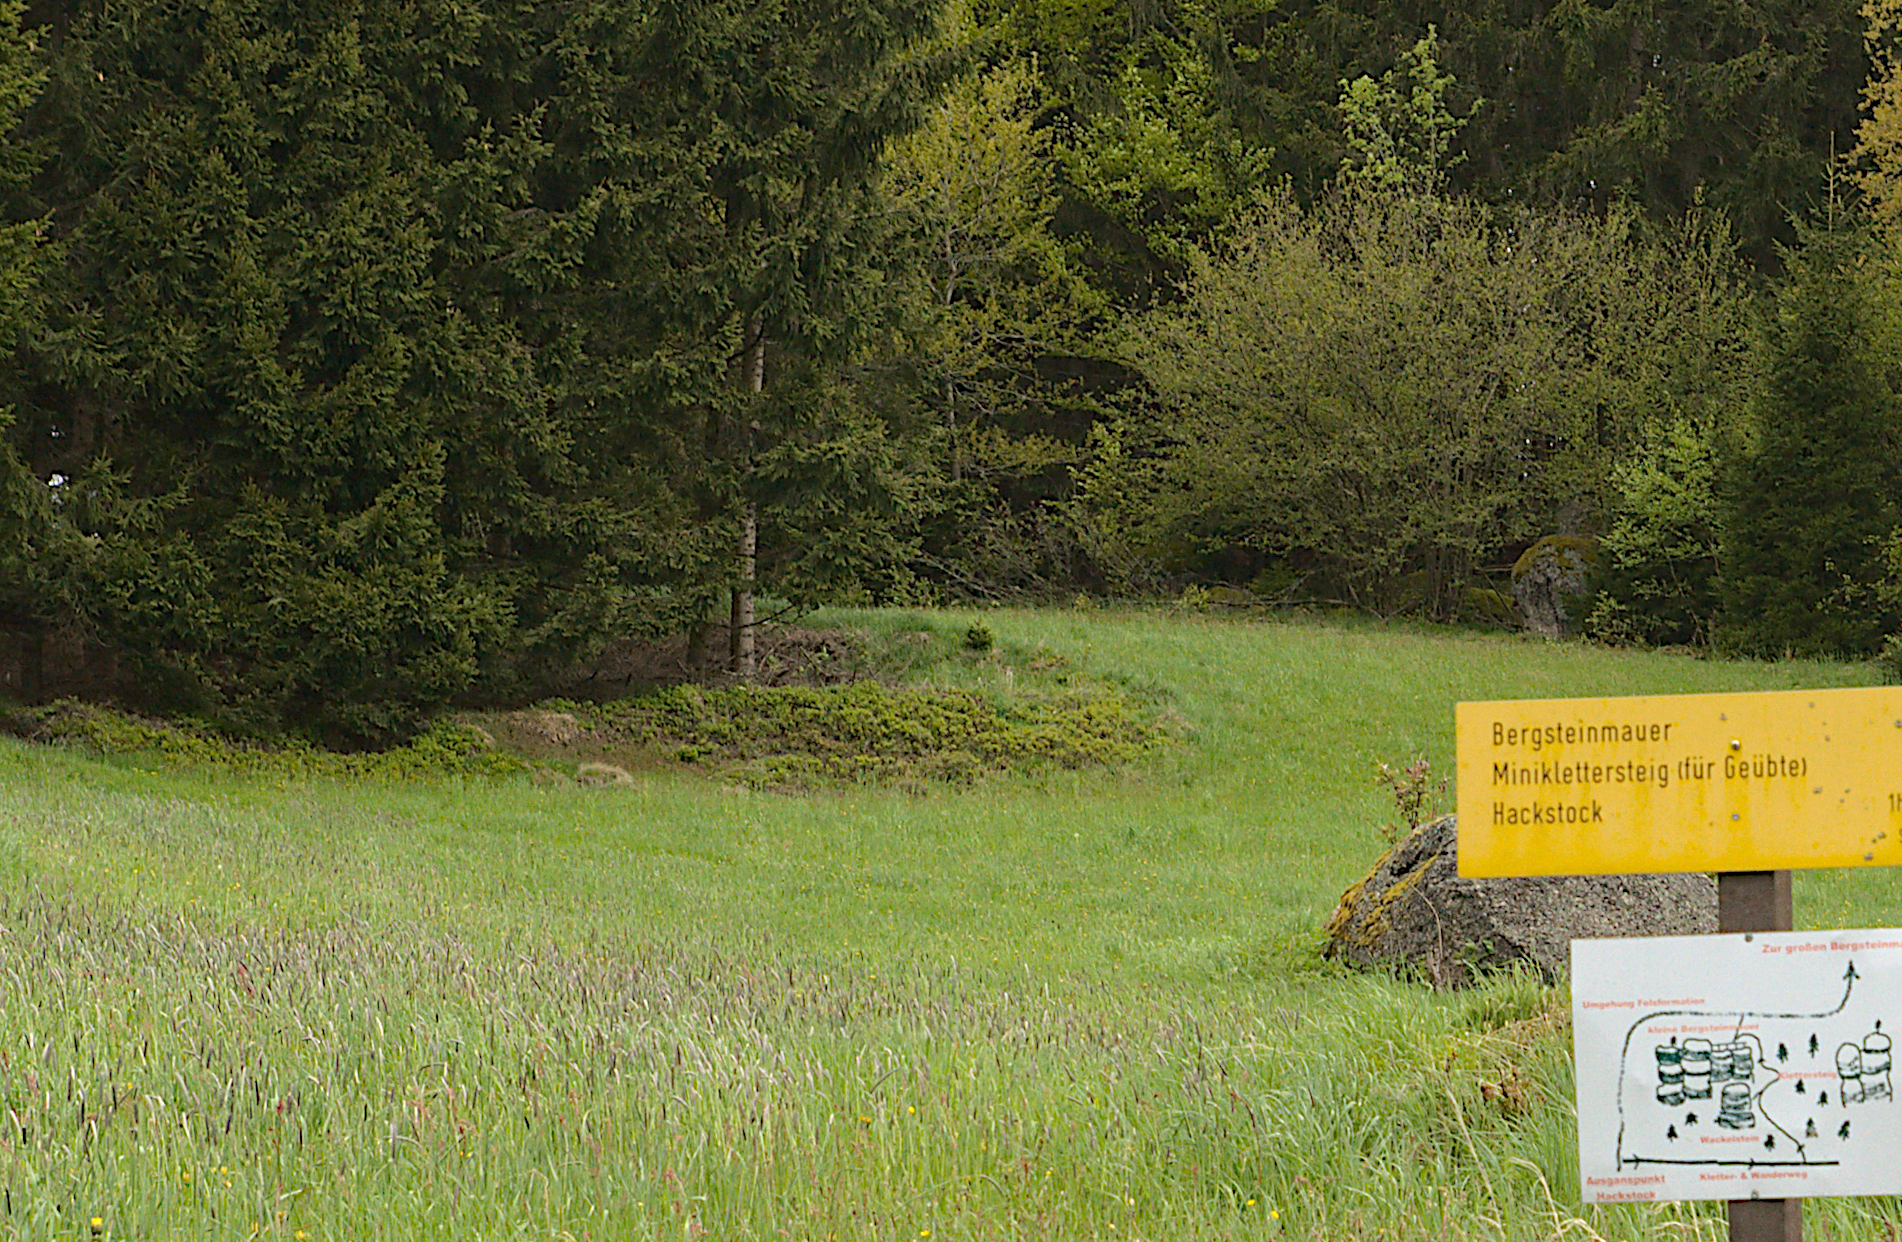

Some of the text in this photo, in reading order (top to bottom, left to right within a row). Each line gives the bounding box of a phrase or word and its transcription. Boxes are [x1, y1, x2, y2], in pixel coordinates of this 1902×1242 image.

[1491, 720, 1672, 751] Bergsteinmauer
[1491, 753, 1808, 788] Miniklettersteig (für Geübte)
[1491, 799, 1603, 826] Hackstock
[1762, 944, 1782, 954] Zur
[1785, 942, 1827, 955] großen
[1582, 1000, 1635, 1010] Umgehung
[1700, 1134, 1760, 1144] Wackelstein
[1586, 1174, 1666, 1188] Ausganspunkt
[1740, 1172, 1748, 1180] &
[1751, 1170, 1808, 1181] Wanderweg
[1596, 1191, 1656, 1200] Hackstock
